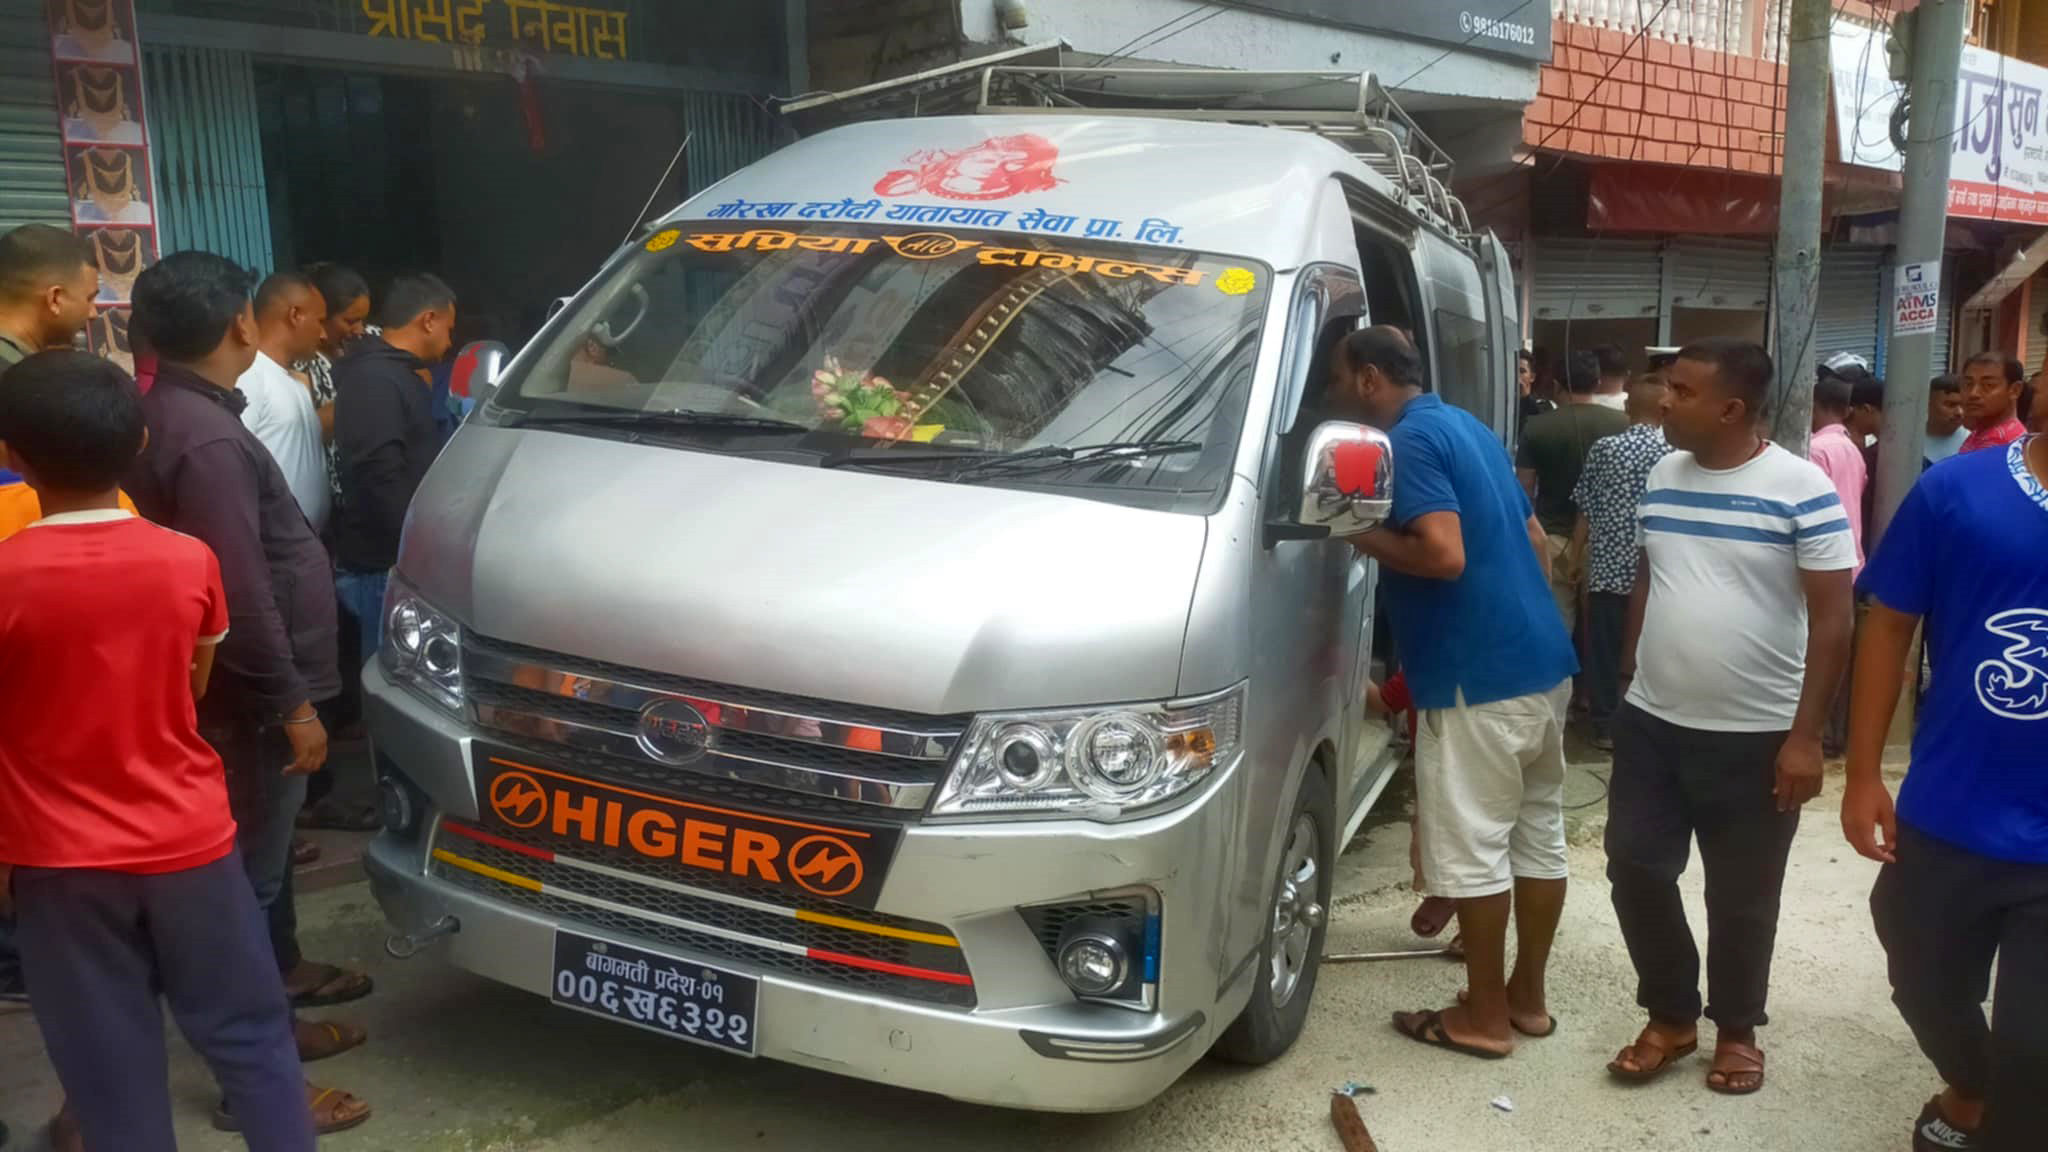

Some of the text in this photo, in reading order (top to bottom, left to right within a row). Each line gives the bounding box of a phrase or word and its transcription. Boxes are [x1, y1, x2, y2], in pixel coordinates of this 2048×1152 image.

[684, 229, 878, 254] सुप्रिया
[707, 199, 797, 219] गोरखा
[886, 203, 1012, 227] यातायात
[1017, 207, 1080, 233] सेवा
[1083, 217, 1122, 238] प्रा.
[1135, 217, 1185, 244] लि.
[551, 789, 782, 883] HIGER
